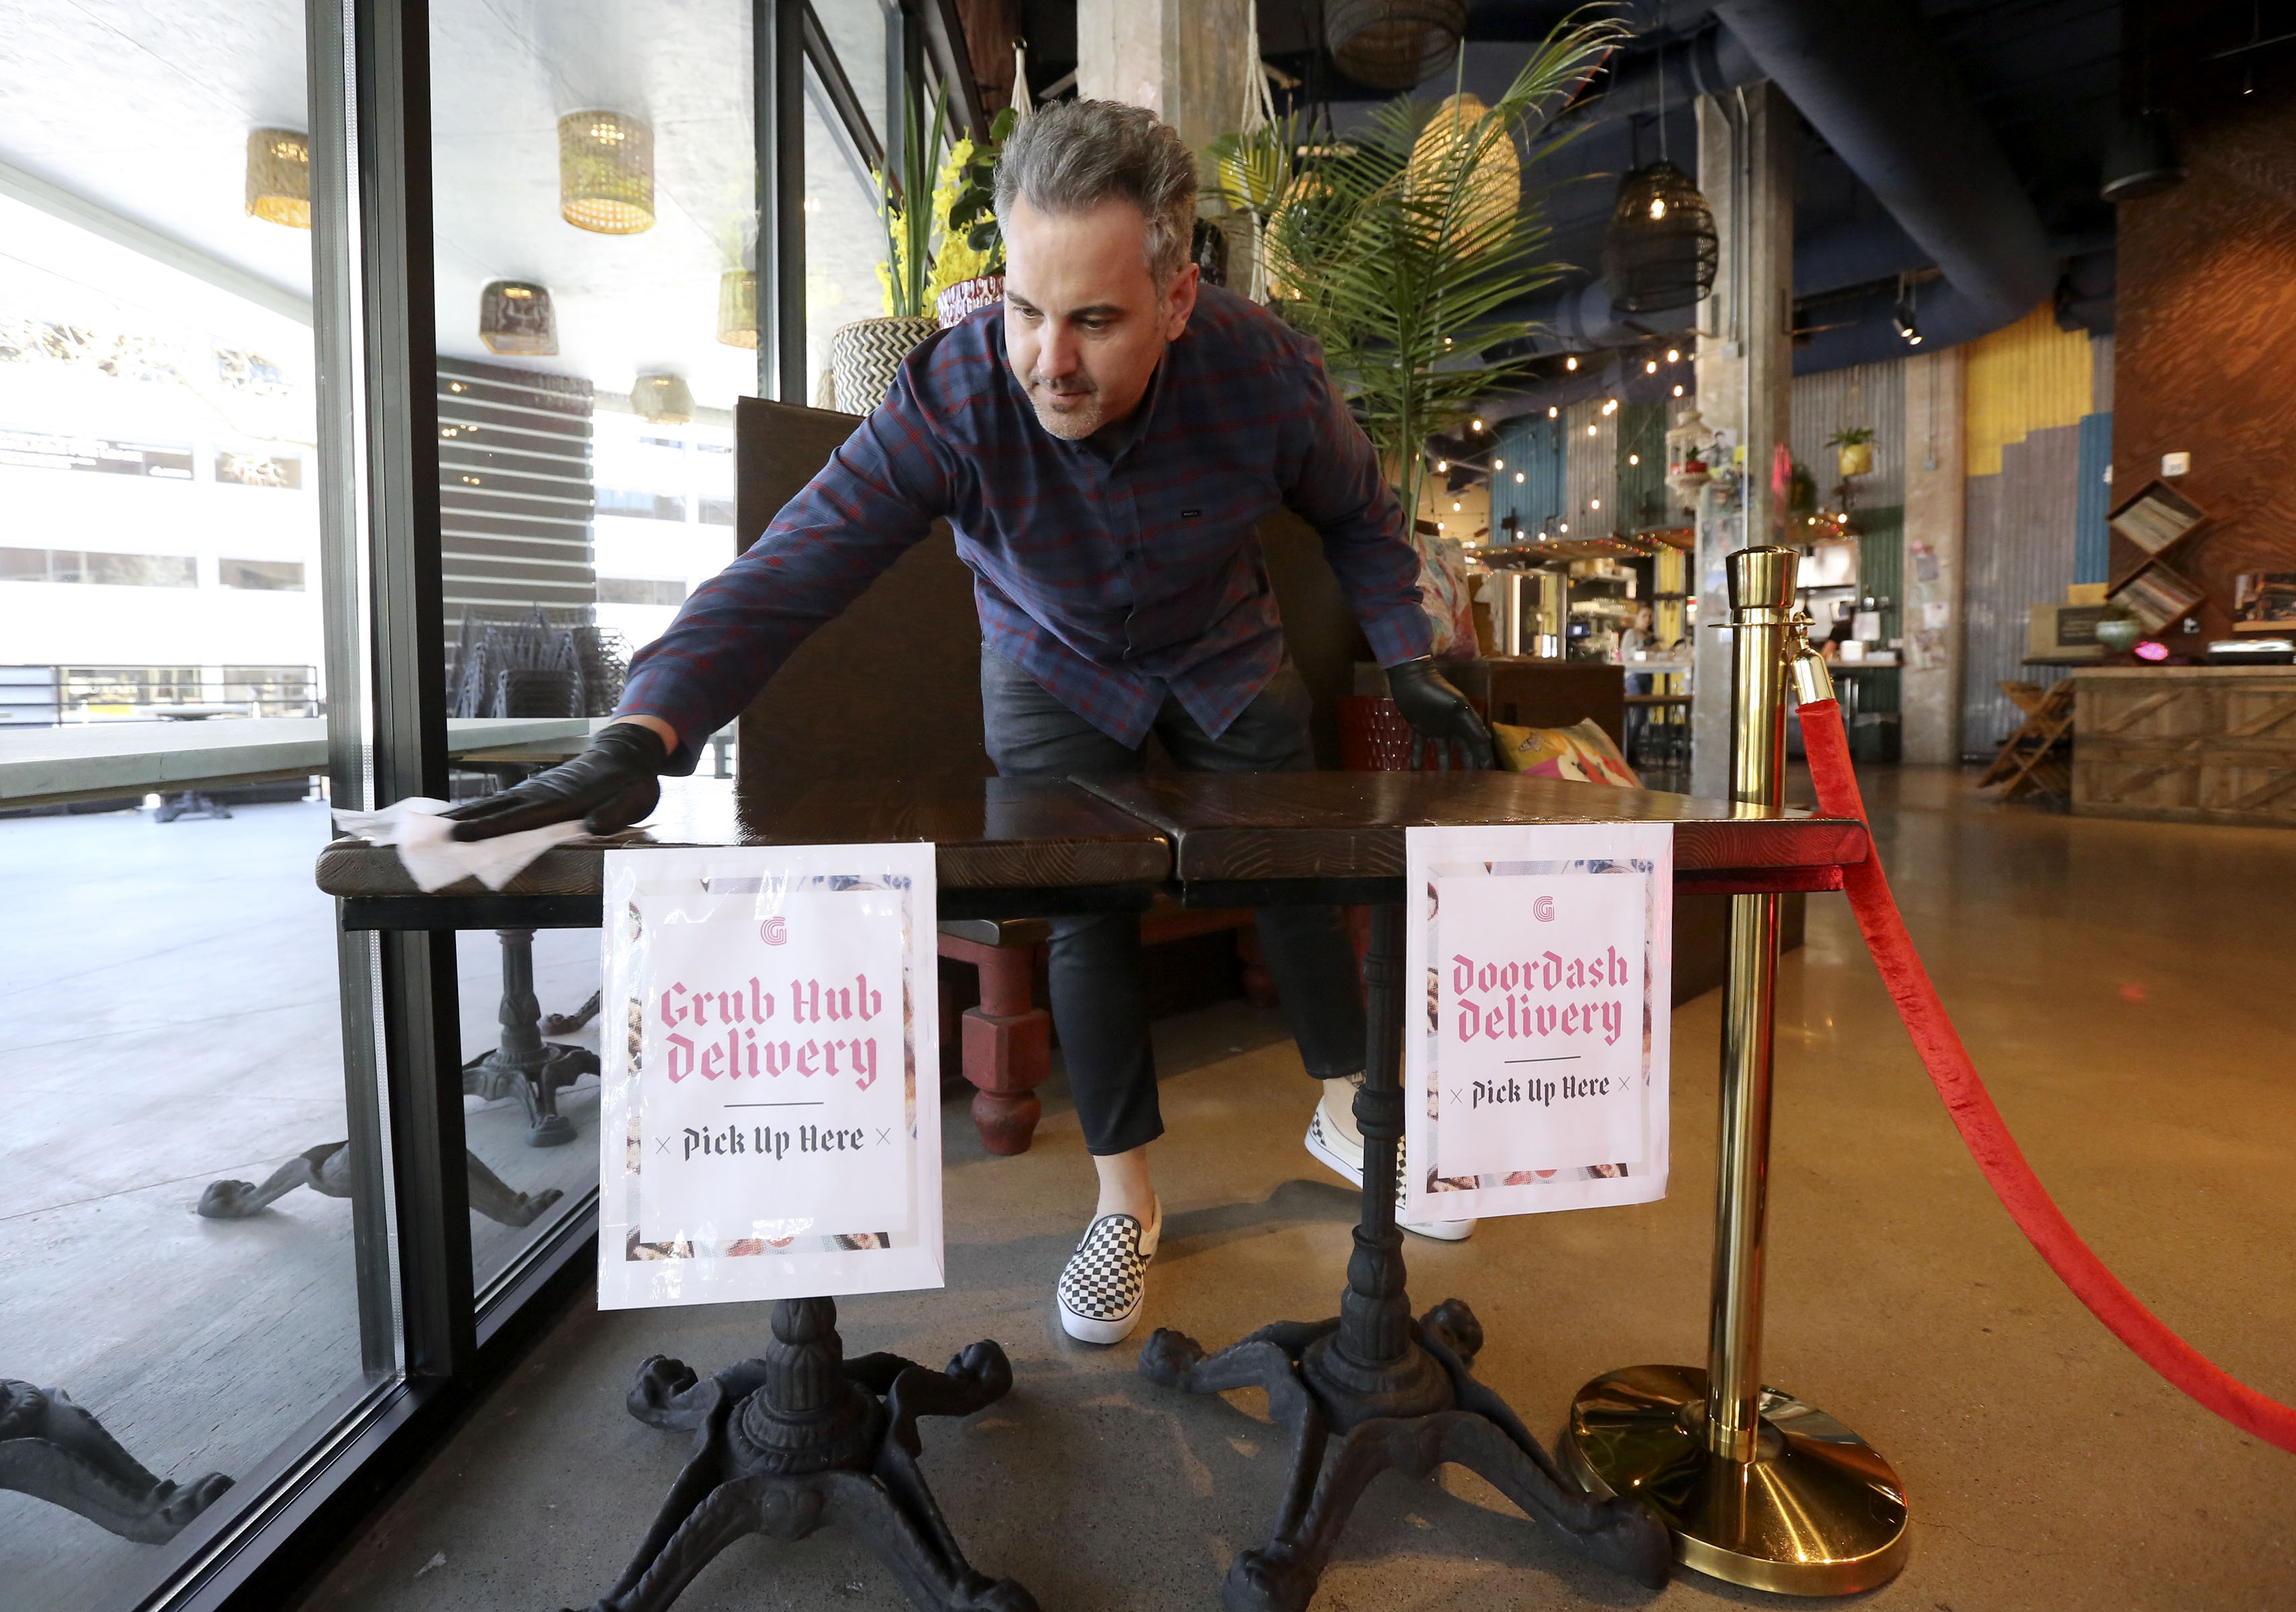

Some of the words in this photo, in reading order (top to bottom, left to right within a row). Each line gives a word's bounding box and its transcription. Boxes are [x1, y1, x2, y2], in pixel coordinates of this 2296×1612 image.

[1533, 895, 1555, 923] G
[661, 977, 775, 1028] Grub
[791, 973, 882, 1024] Hub
[1473, 1077, 1521, 1110] Pick
[1528, 1078, 1555, 1108] Up
[1562, 1075, 1610, 1100] Here
[683, 1124, 745, 1161] Pick
[754, 1125, 790, 1161] Up
[799, 1124, 864, 1153] Here
